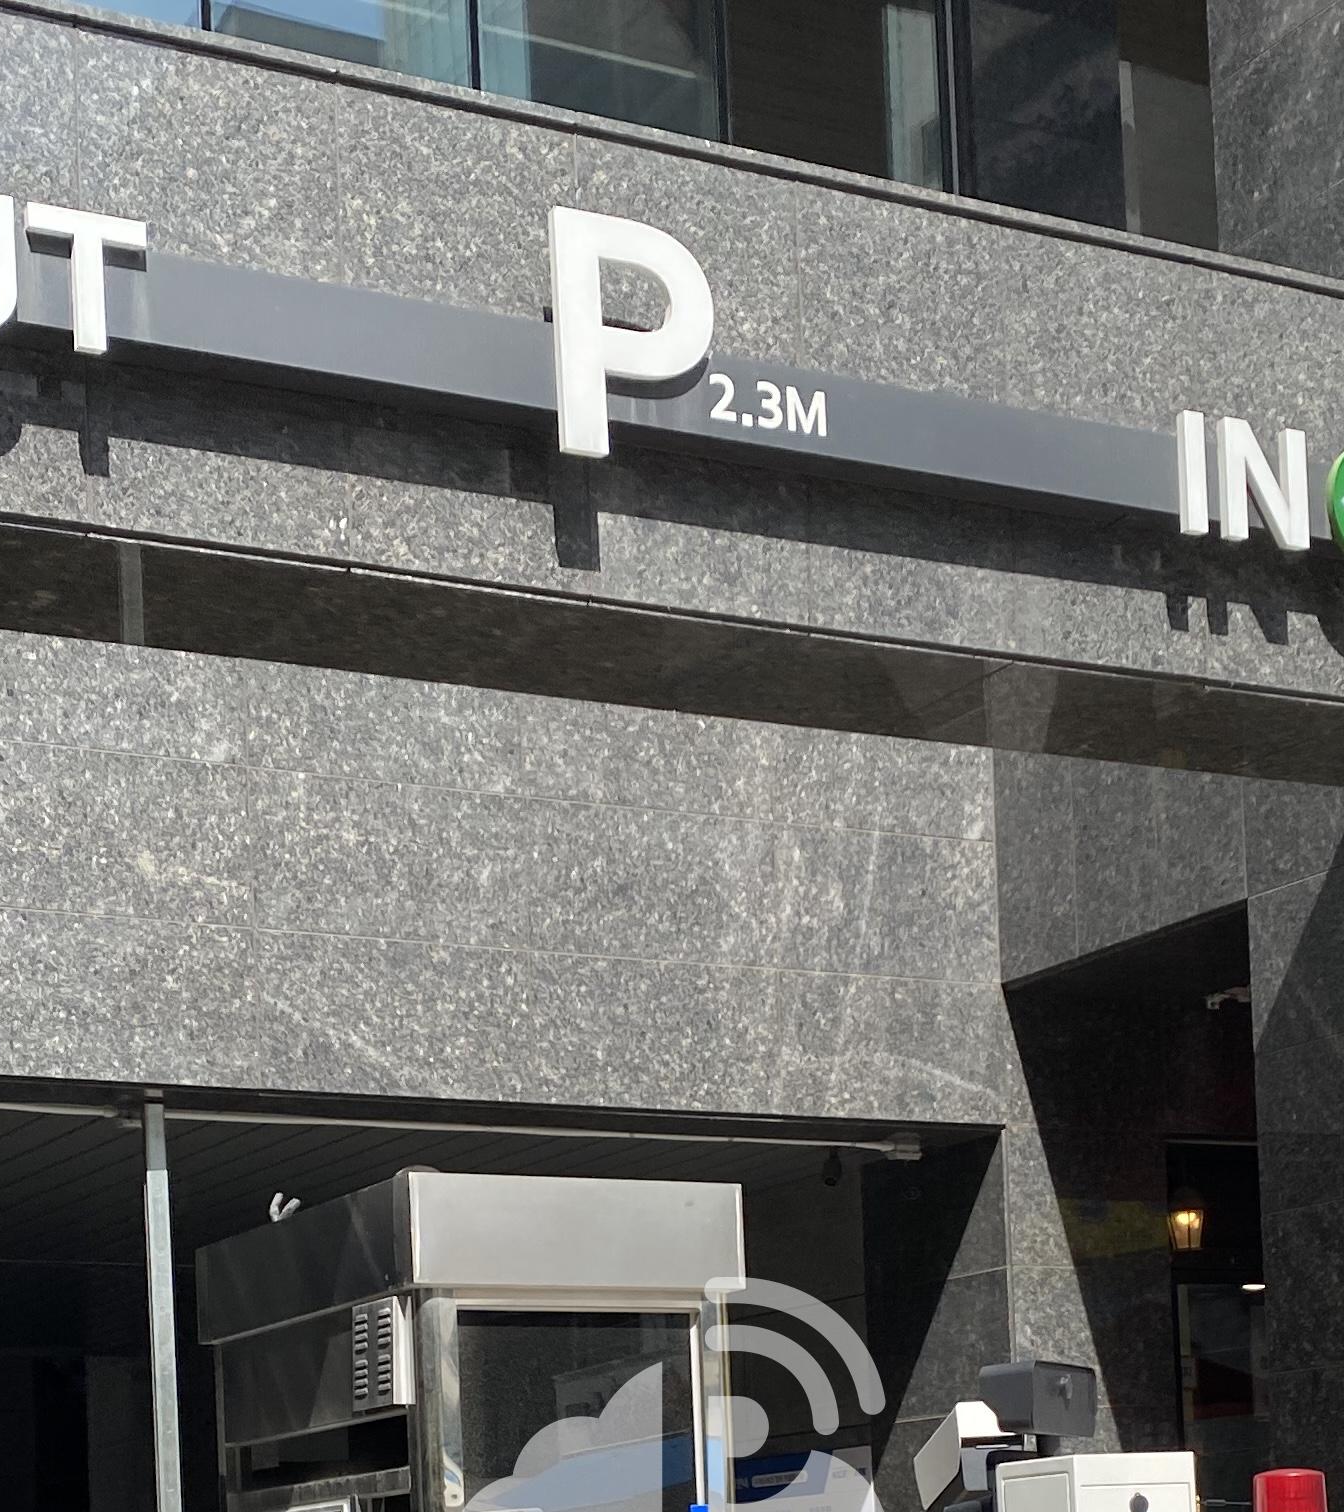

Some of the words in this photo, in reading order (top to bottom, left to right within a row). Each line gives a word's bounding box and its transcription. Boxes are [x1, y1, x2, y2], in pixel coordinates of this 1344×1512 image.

[551, 205, 714, 458] P
[707, 372, 829, 438] 2.3M
[1175, 408, 1311, 551] IN
